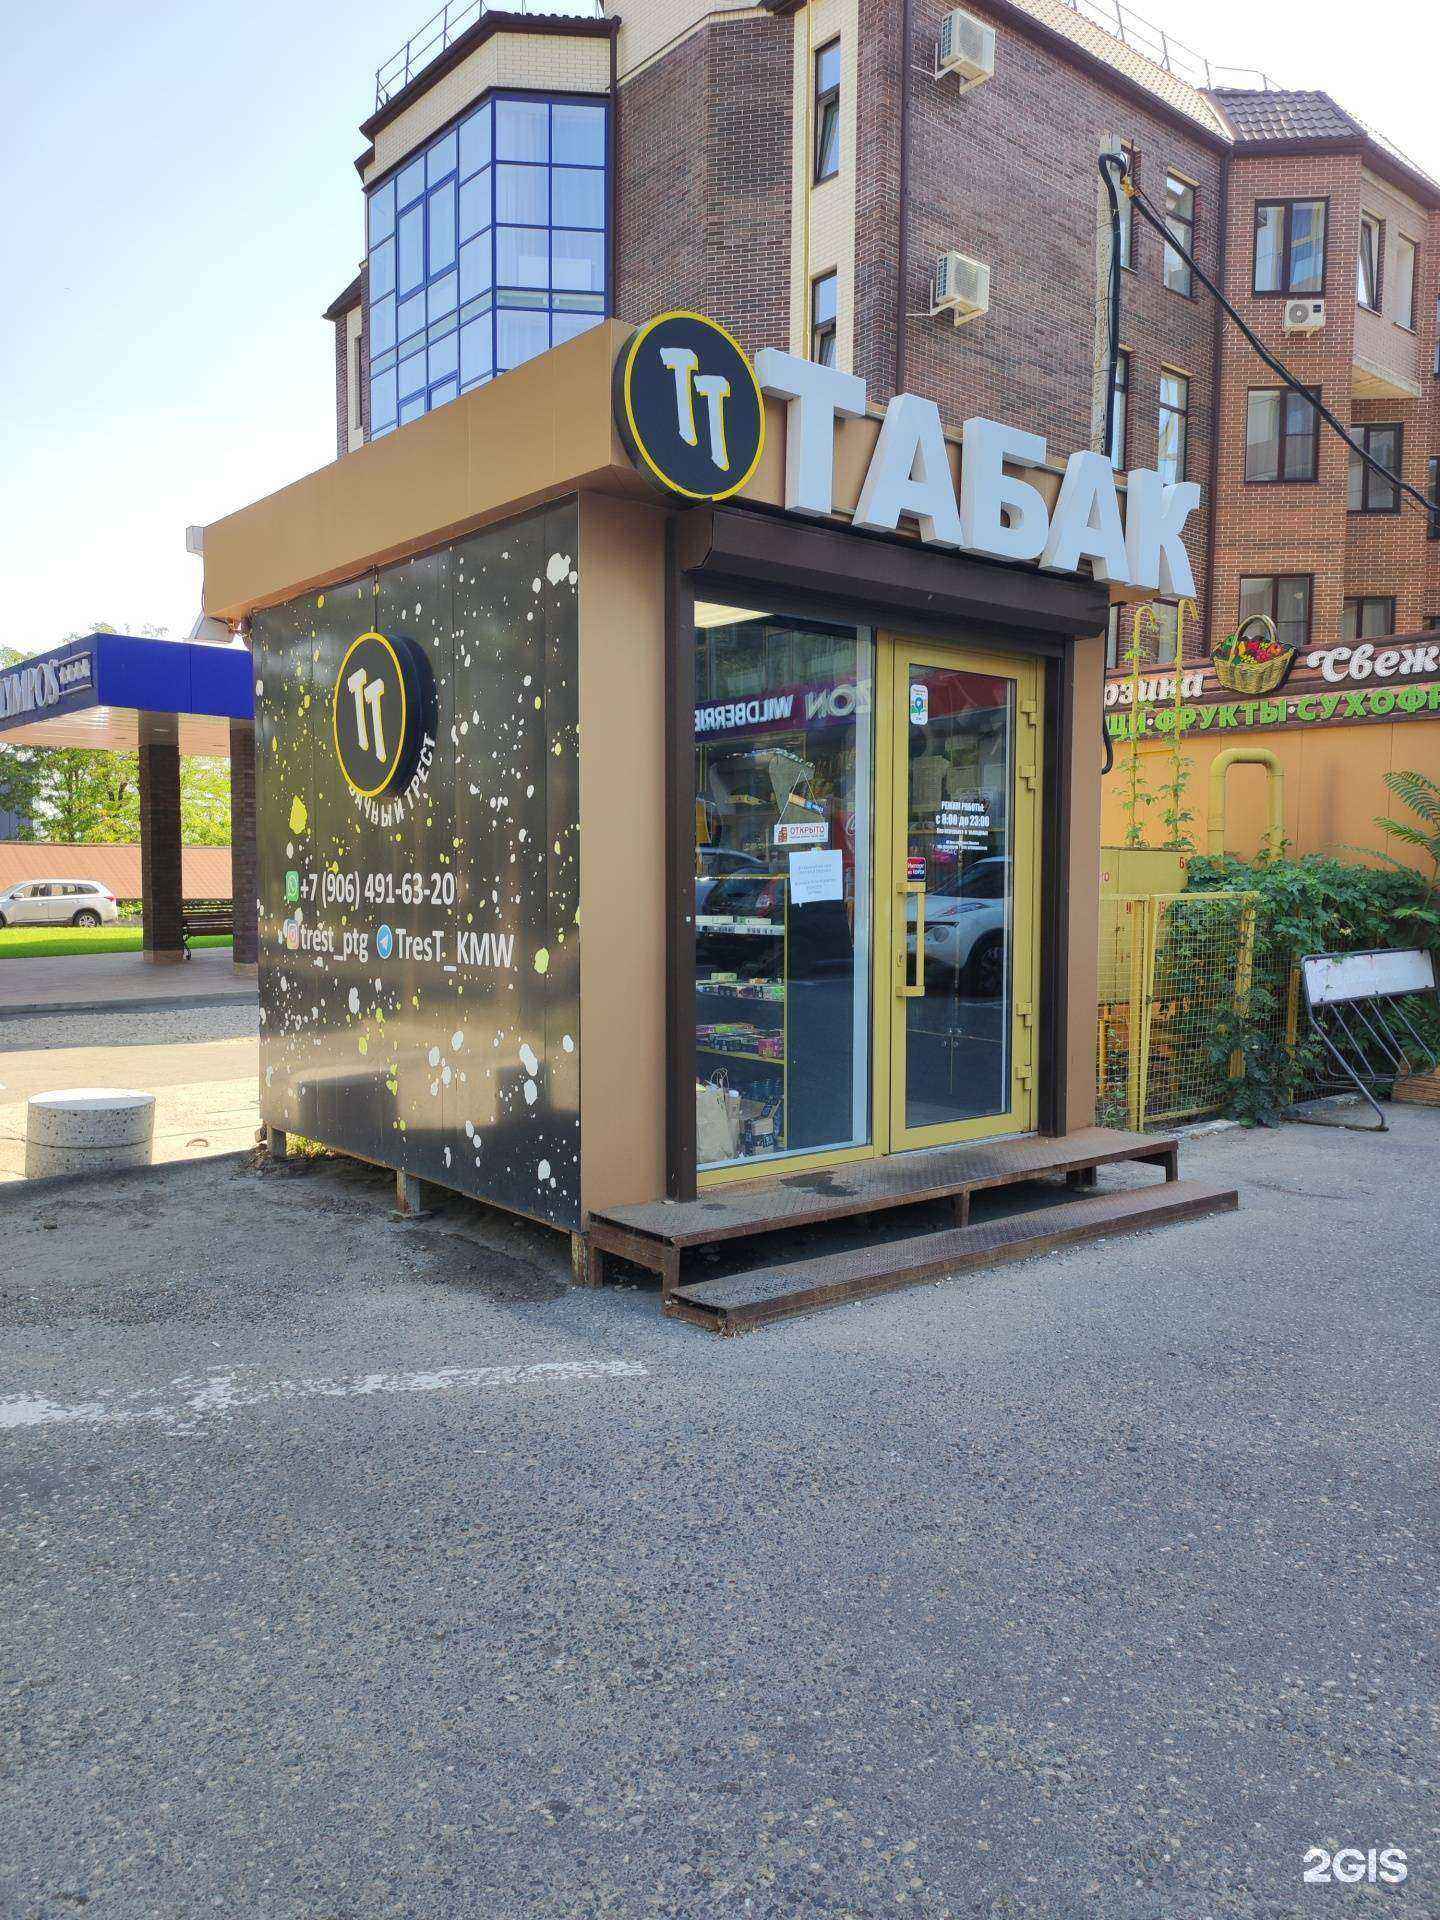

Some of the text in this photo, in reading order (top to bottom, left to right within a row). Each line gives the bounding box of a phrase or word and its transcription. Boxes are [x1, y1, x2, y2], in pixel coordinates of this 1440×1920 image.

[754, 346, 1201, 600] ТАБАК
[790, 826, 825, 835] ОТКРЫТО
[300, 871, 456, 910] +7 (906) 491-63-20
[300, 924, 369, 964] trest_ptg
